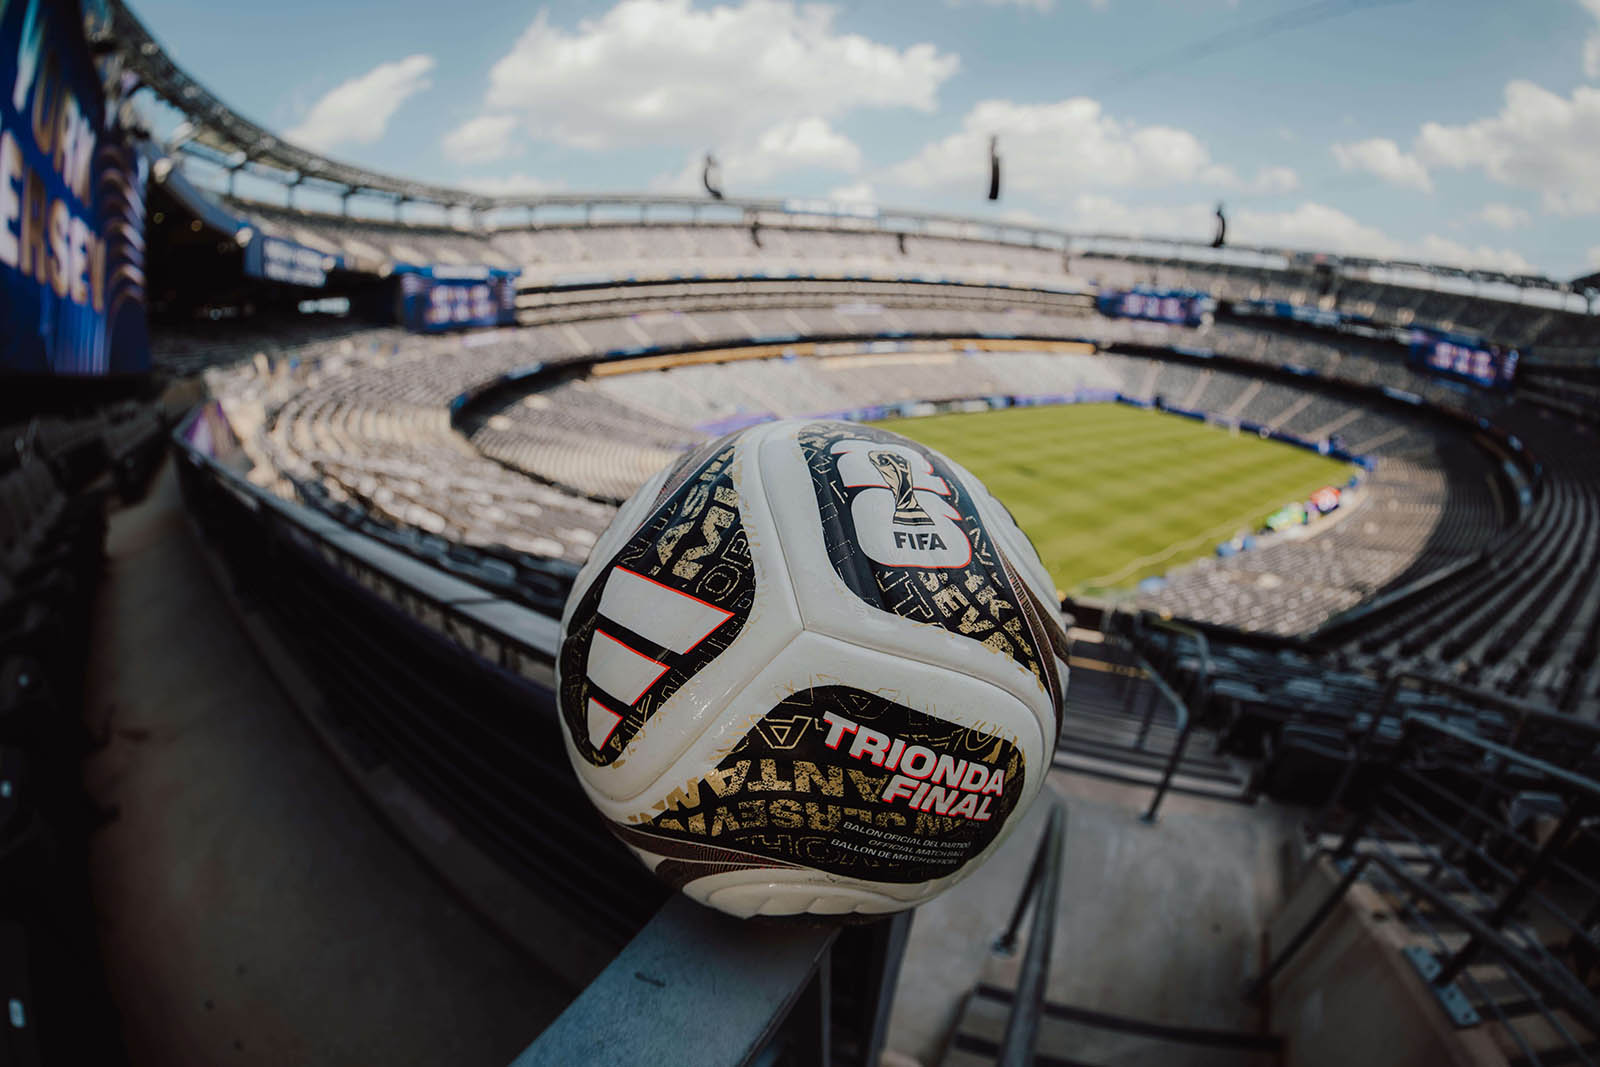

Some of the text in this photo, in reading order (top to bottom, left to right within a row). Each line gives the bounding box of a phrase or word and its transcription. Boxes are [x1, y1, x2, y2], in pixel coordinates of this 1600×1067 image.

[0, 130, 106, 313] ERSEY
[893, 531, 948, 551] FIFA
[823, 710, 1005, 797] TRIONDA
[881, 774, 993, 821] FINAL
[831, 838, 877, 856] BALLON
[877, 850, 893, 859] DE
[868, 839, 914, 854] OFFICIAL
[883, 832, 921, 846] OFICIAL
[922, 839, 939, 848] DEL
